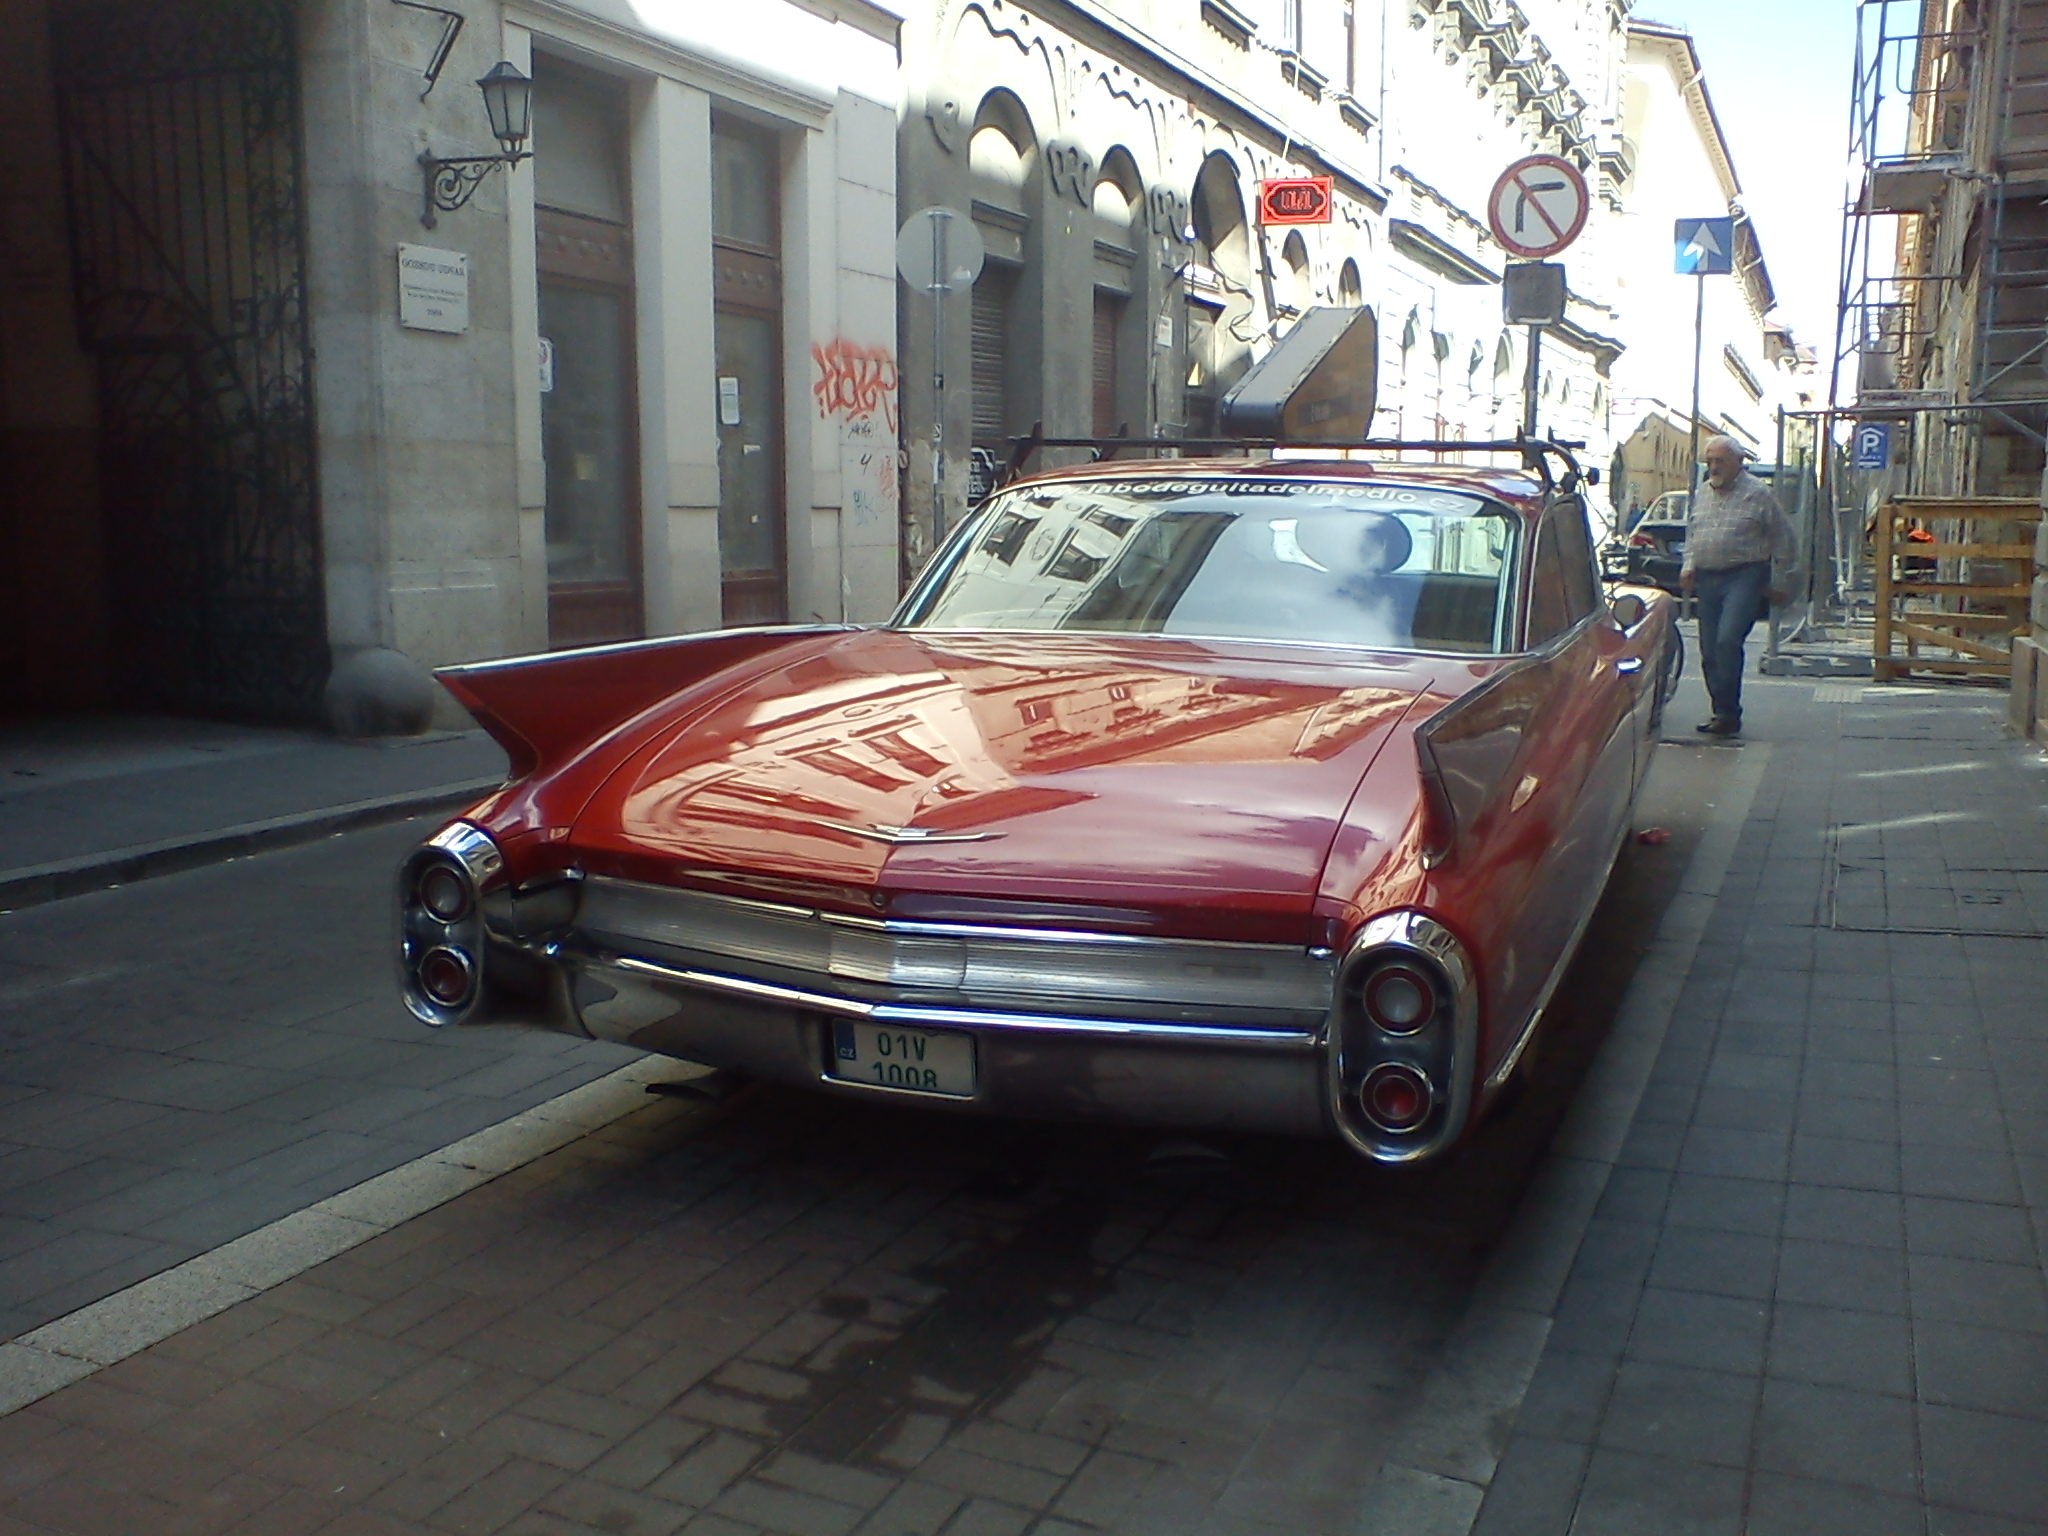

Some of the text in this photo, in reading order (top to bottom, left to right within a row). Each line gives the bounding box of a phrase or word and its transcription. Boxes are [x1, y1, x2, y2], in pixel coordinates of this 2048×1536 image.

[1863, 433, 1880, 455] P
[877, 1032, 926, 1061] 01V
[872, 1061, 938, 1088] 1008
